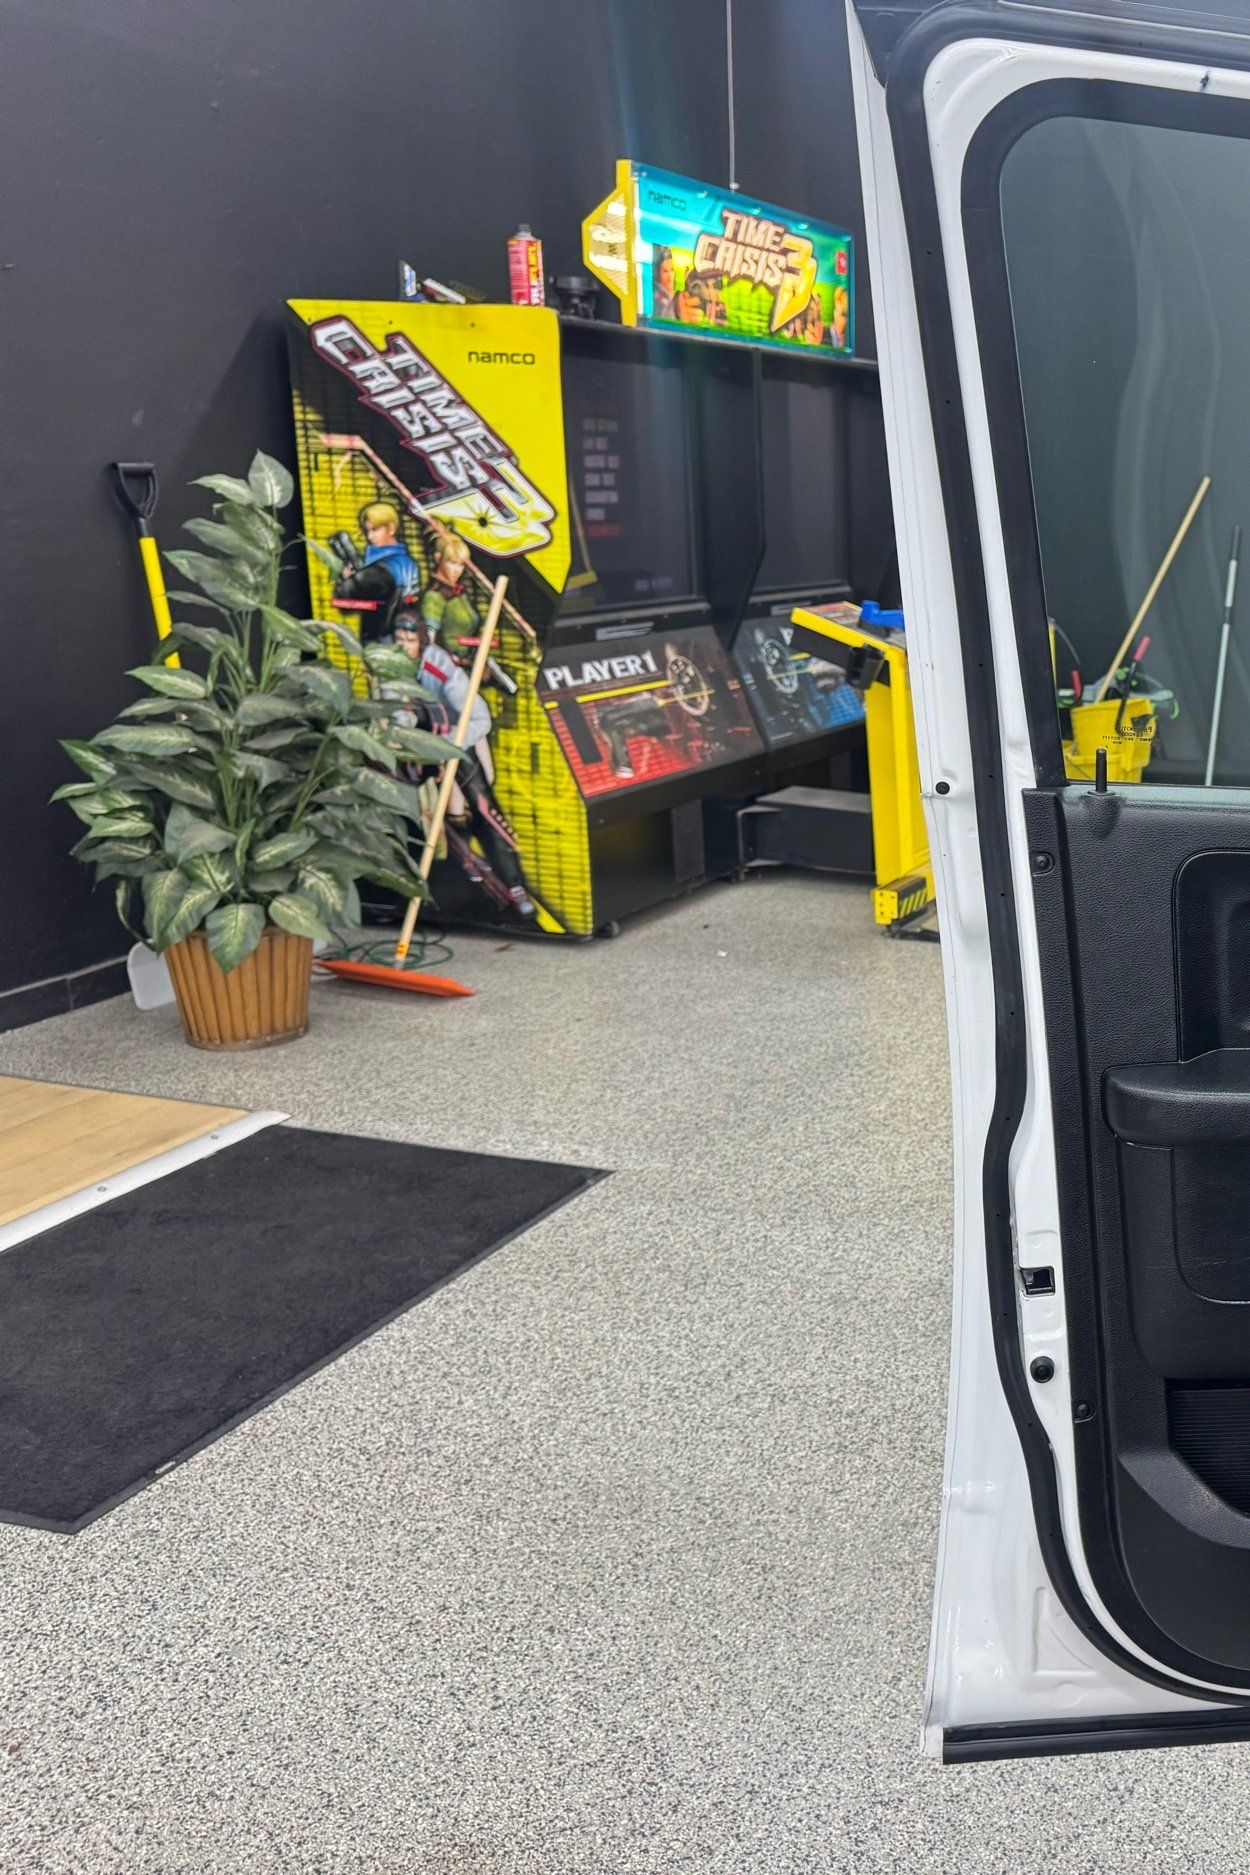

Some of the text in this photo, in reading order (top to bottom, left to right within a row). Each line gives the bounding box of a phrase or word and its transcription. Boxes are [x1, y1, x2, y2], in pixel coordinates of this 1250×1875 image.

[722, 209, 787, 251] TIME
[694, 234, 788, 285] CRISIS
[468, 351, 535, 365] namco
[313, 317, 490, 490] CRISIS
[386, 335, 503, 459] TIME
